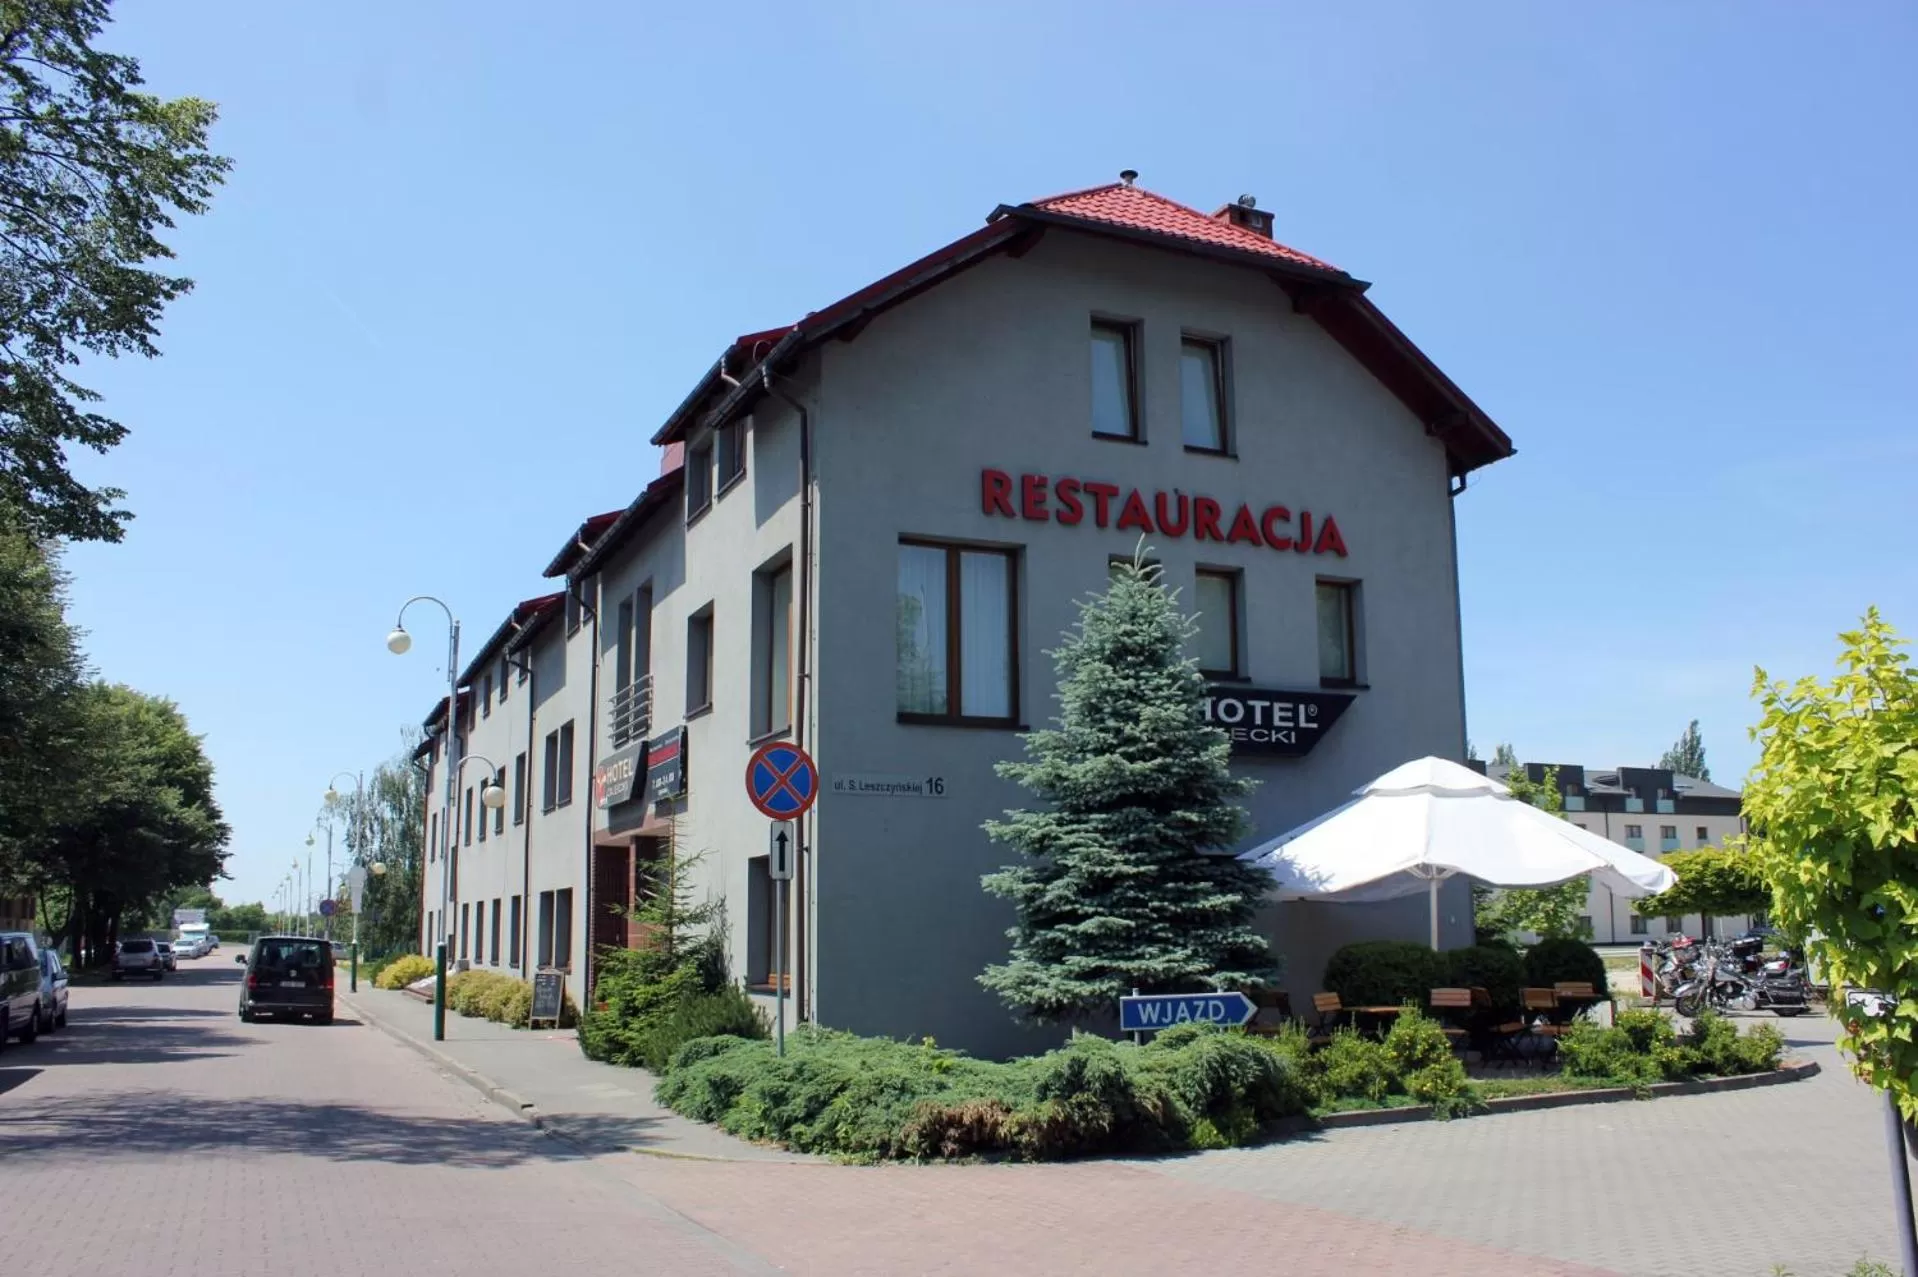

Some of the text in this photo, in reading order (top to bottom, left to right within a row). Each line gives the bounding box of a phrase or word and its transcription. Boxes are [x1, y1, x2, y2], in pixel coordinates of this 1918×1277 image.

[981, 468, 1348, 557] RESTAURACJA
[606, 756, 633, 783] HOTEL
[926, 776, 945, 795] 16
[1138, 1000, 1225, 1024] WJAZD
